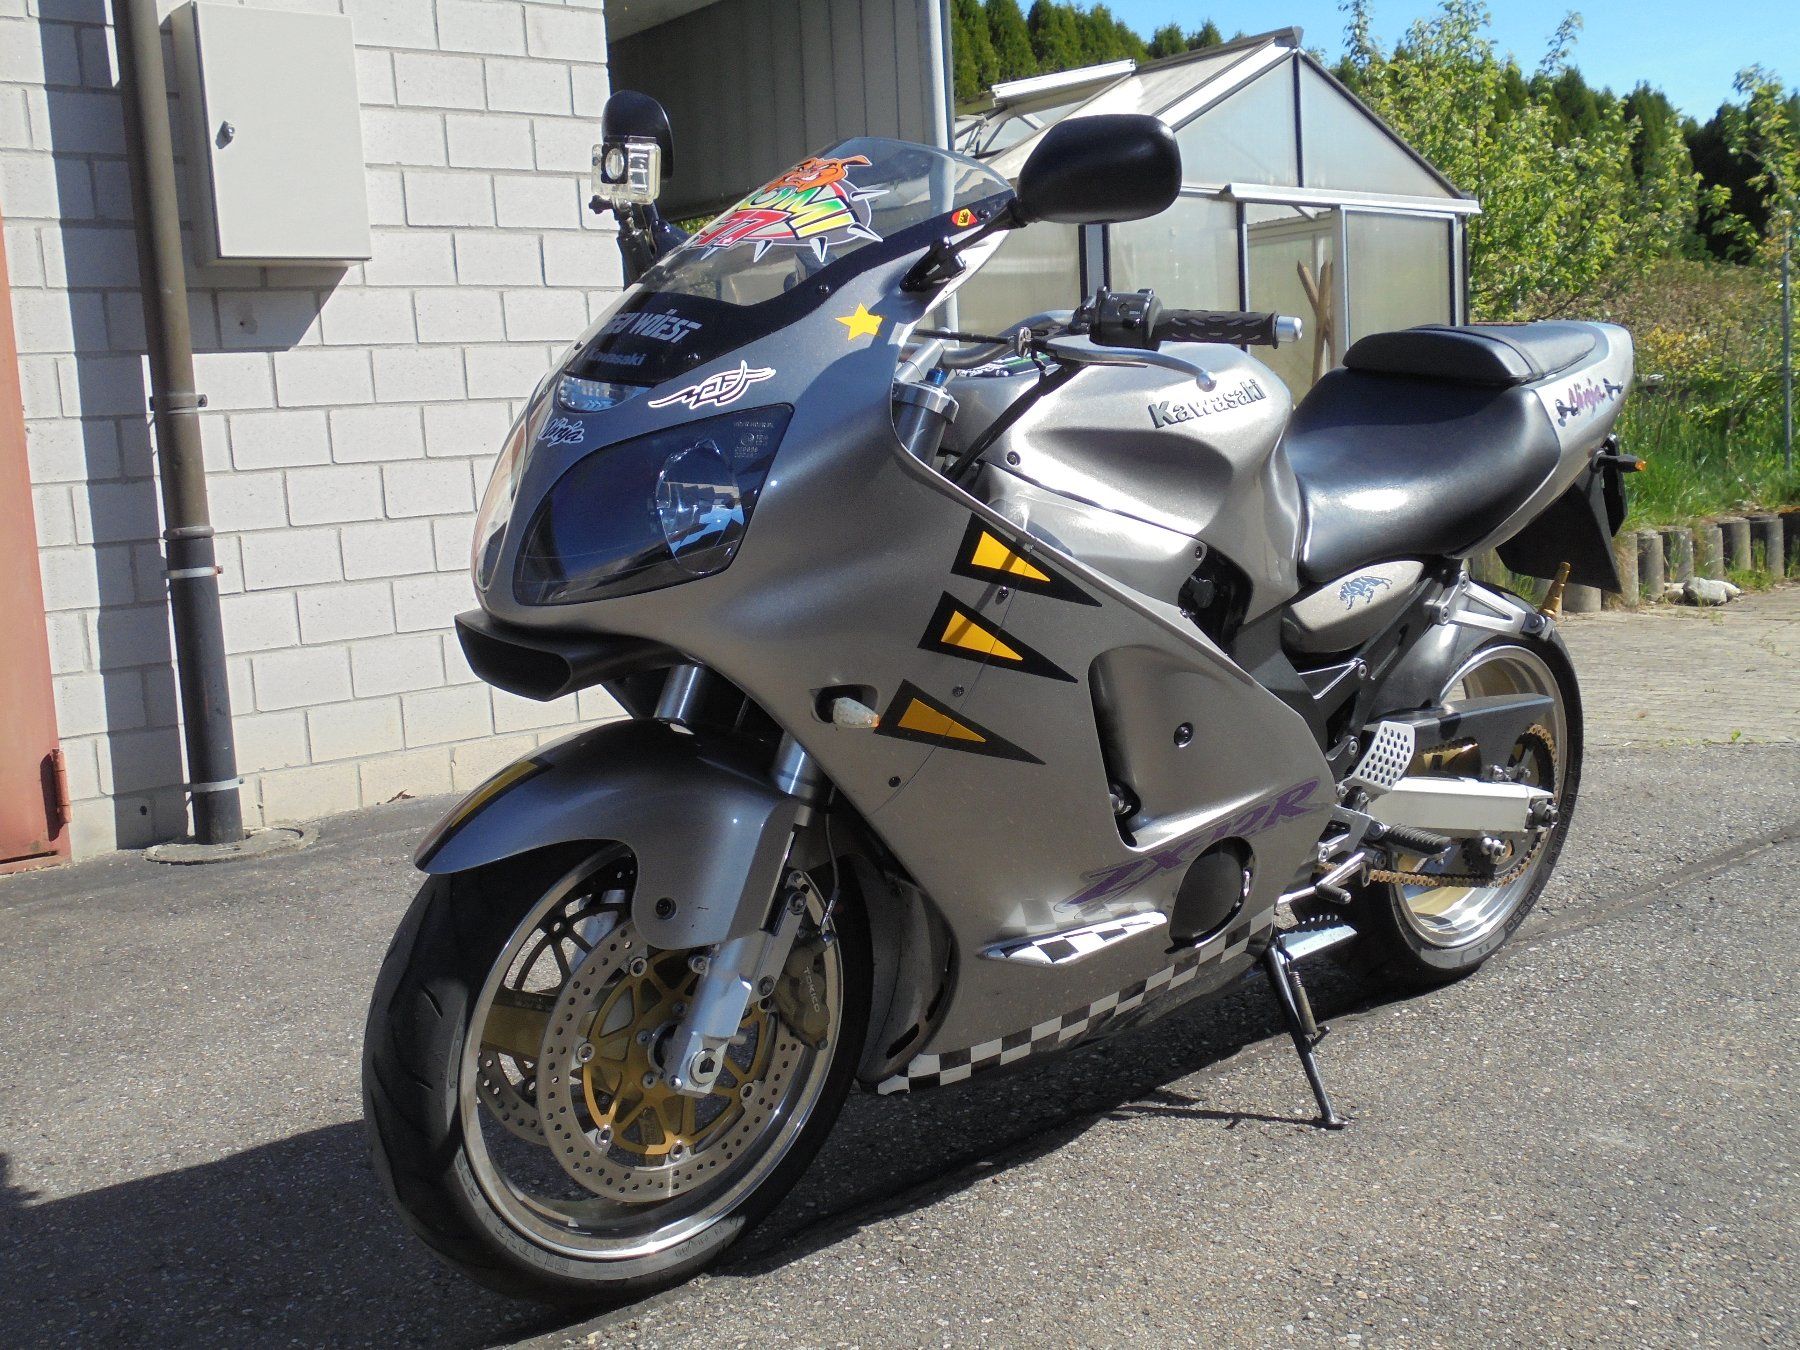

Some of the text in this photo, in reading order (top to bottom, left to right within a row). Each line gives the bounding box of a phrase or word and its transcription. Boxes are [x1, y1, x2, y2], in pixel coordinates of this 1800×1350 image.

[1148, 379, 1266, 429] Kawasaki
[1567, 378, 1606, 416] Ninja
[538, 417, 584, 447] Ninja
[803, 966, 820, 1012] TOKICO
